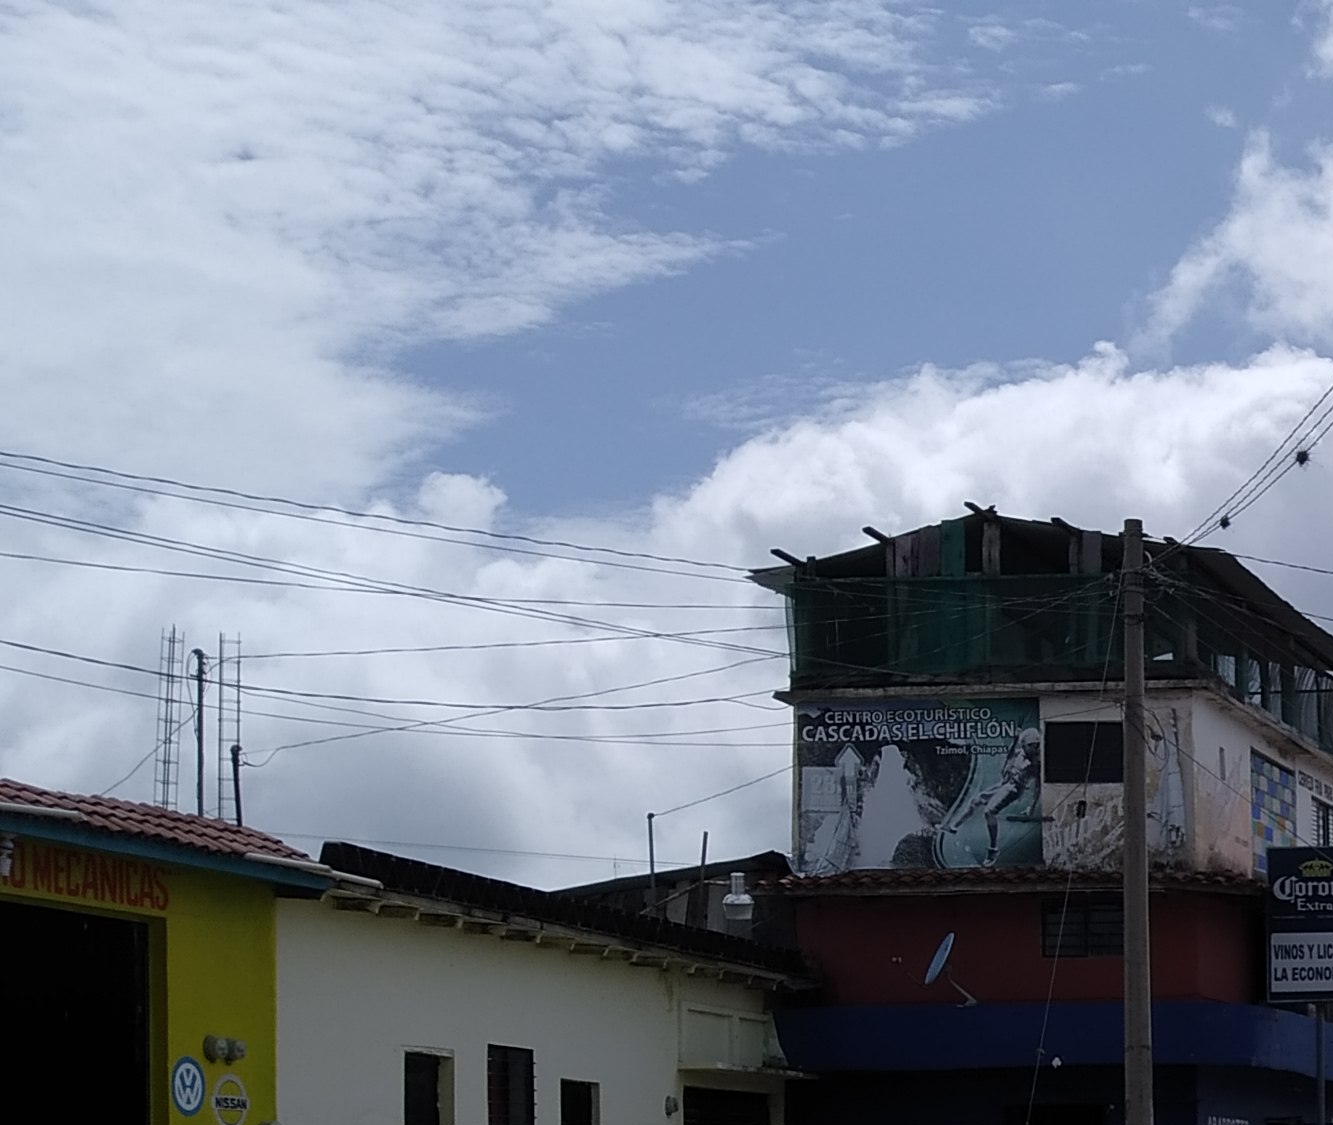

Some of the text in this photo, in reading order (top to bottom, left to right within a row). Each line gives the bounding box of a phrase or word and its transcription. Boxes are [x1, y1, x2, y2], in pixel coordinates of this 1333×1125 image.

[824, 707, 991, 724] CENTRO ECOTURÍSTICO
[801, 718, 1015, 742] CASCADAS EL CHIFLÓN
[935, 745, 1008, 756] Tzimol, Chiapas
[33, 845, 169, 911] MECANICAS
[1296, 898, 1333, 911] Extra
[1273, 944, 1305, 960] VINOS
[1307, 944, 1315, 959] Y
[1274, 967, 1289, 981] LA
[215, 1096, 247, 1109] NISSAN
